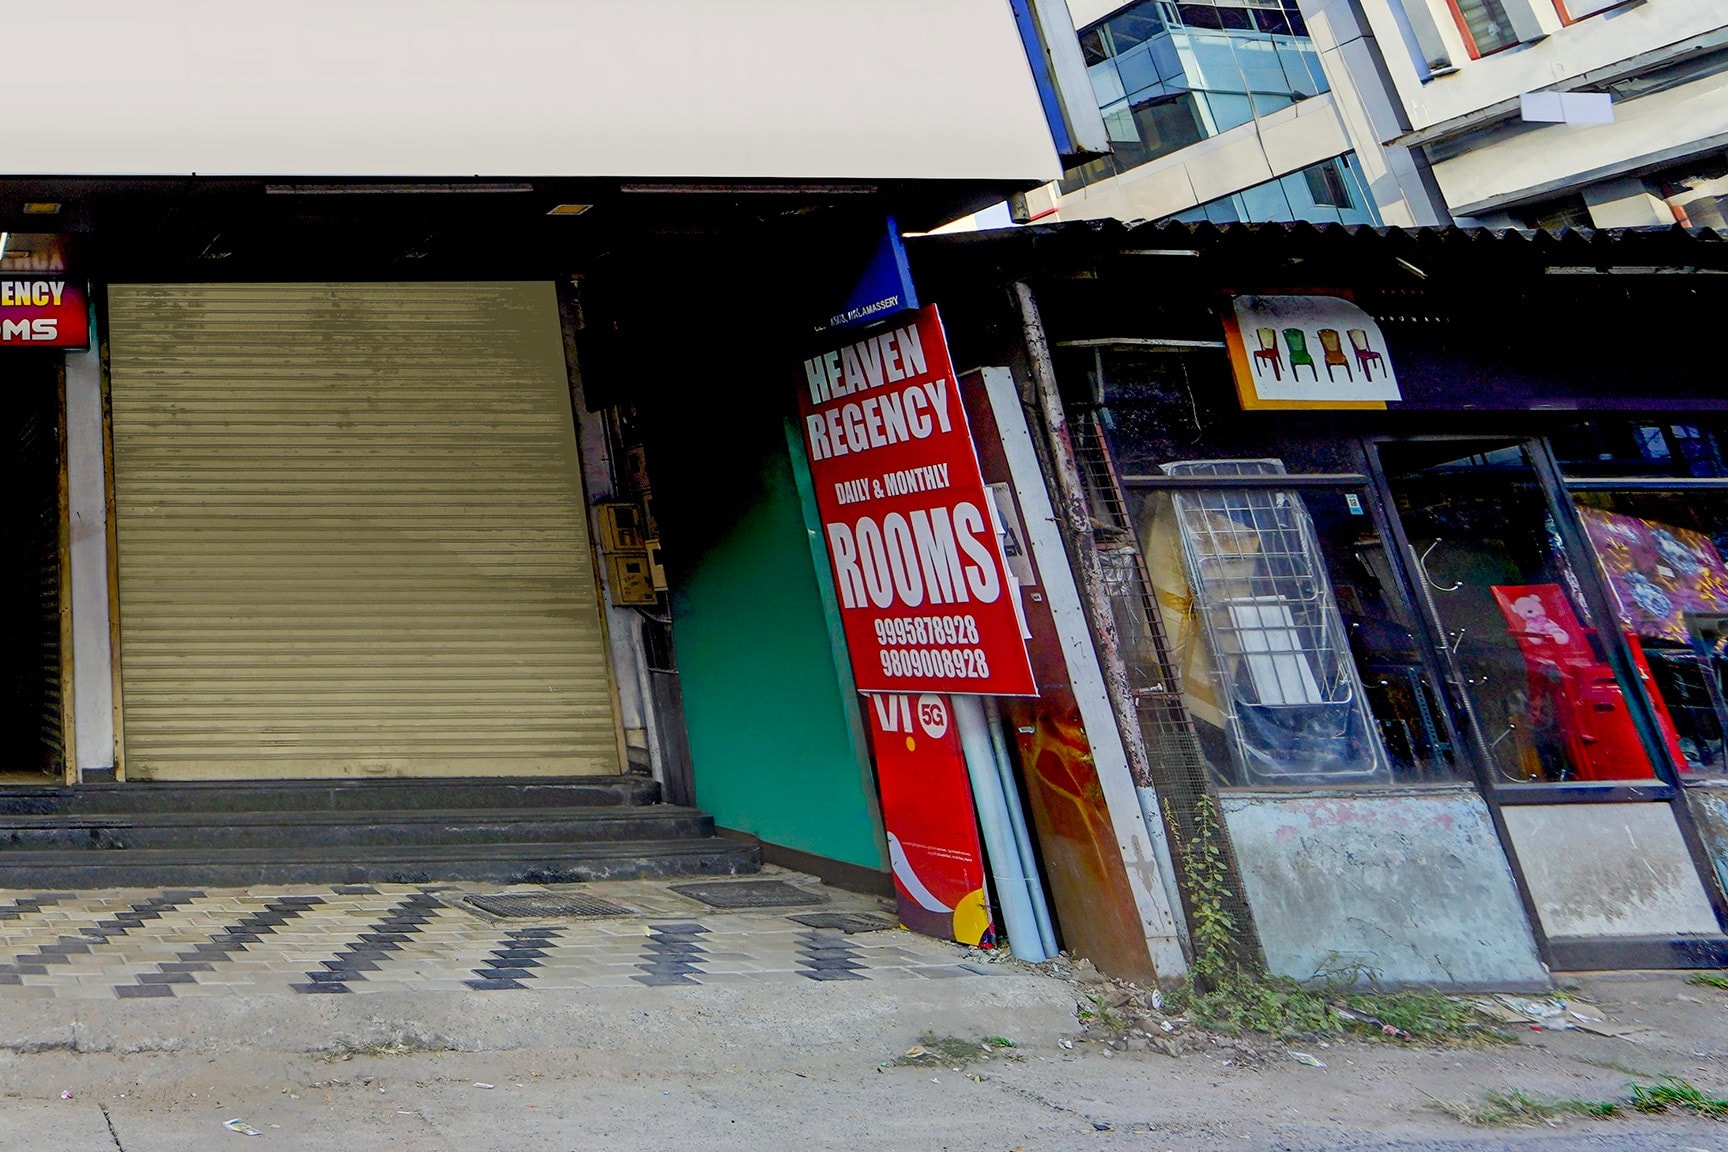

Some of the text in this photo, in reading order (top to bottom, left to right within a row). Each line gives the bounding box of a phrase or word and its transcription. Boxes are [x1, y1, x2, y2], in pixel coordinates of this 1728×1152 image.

[804, 323, 928, 405] HEAVEN
[806, 379, 952, 461] REGENCY
[834, 463, 951, 505] DAILY & MONTHLY
[826, 501, 1000, 609] ROOMS
[874, 614, 980, 645] 9995878928
[880, 648, 990, 678] 9809008928
[921, 703, 944, 726] 5G
